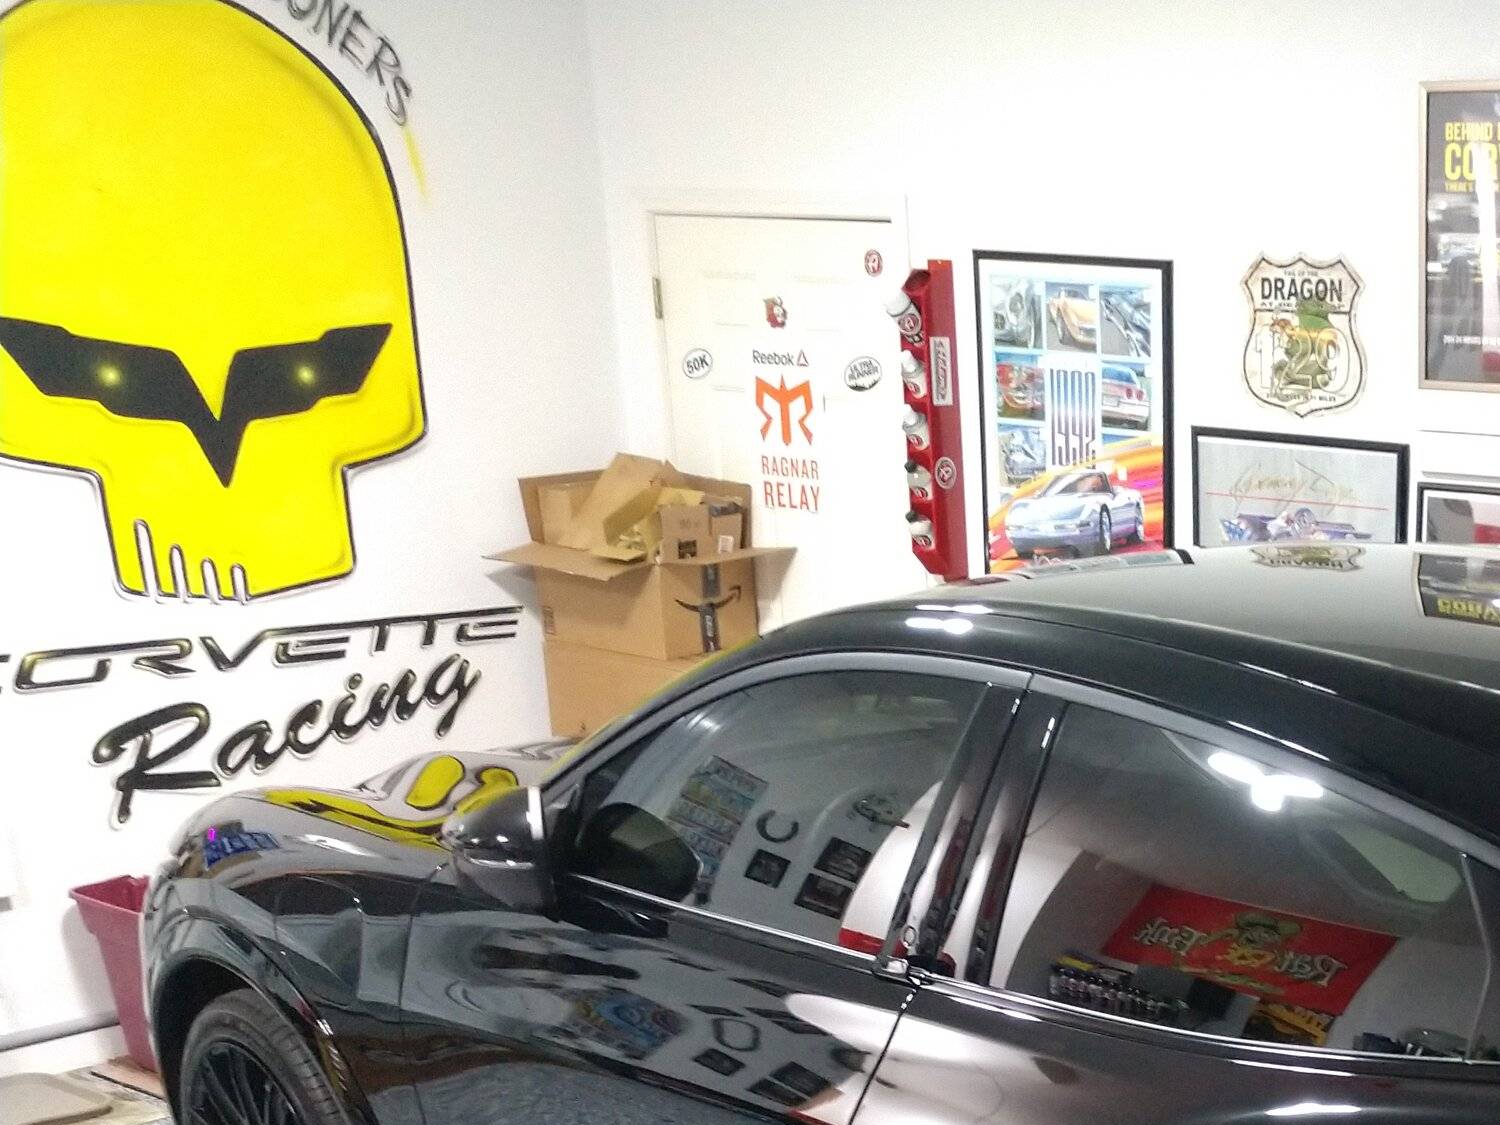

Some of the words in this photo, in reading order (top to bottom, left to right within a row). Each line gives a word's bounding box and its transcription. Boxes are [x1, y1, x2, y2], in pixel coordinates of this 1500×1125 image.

[1260, 277, 1343, 303] DRAGON
[686, 354, 709, 374] 50K
[752, 349, 795, 366] Reebok
[1255, 325, 1351, 394] 129
[761, 455, 820, 481] RAGNAR
[763, 480, 820, 511] RELAY
[0, 605, 524, 696] ORVETTE
[92, 653, 483, 826] Racing
